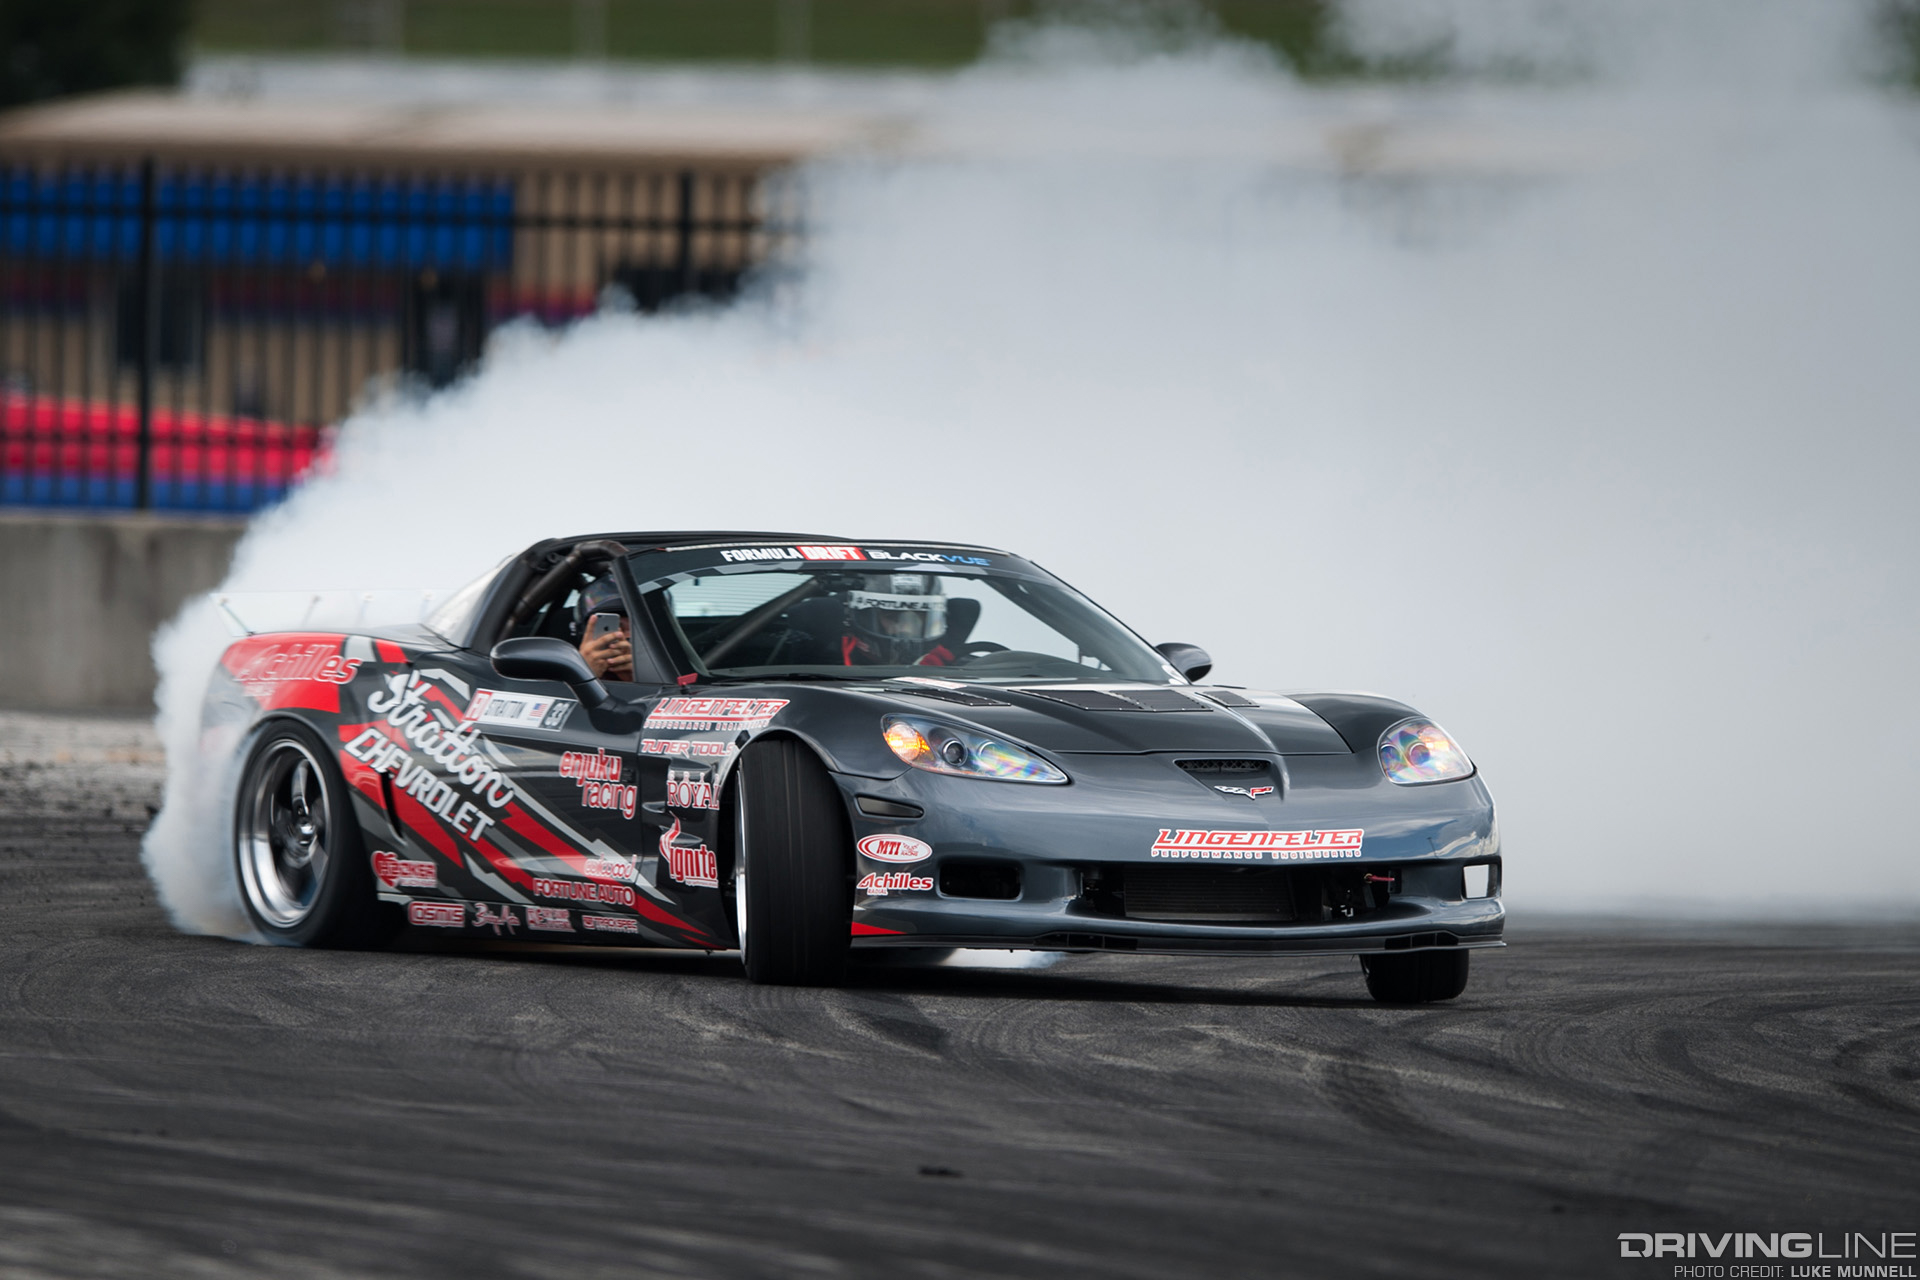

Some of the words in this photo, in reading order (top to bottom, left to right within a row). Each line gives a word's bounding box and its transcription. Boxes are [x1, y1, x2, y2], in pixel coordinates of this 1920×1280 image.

[720, 548, 801, 562] FORMULA
[803, 546, 861, 560] DRIFT
[865, 550, 990, 566] BLACKVUE
[652, 698, 789, 715] LINGENFELTER
[368, 669, 514, 808] Stratton
[642, 740, 690, 759] TUNER
[692, 742, 733, 755] TOOLS
[560, 747, 622, 787] enjuku
[345, 727, 494, 842] CHEVROLET
[582, 781, 637, 819] racing
[667, 781, 720, 810] ROYAL
[1154, 830, 1363, 846] LINGENFELTER
[876, 840, 901, 856] MTI
[1151, 850, 1263, 859] PERFORMANCE
[1272, 850, 1361, 859] ENGINEERING
[669, 845, 718, 882] ignite
[857, 872, 933, 890] Achilles
[534, 879, 598, 901] FORTUNE
[598, 884, 635, 906] AUTO
